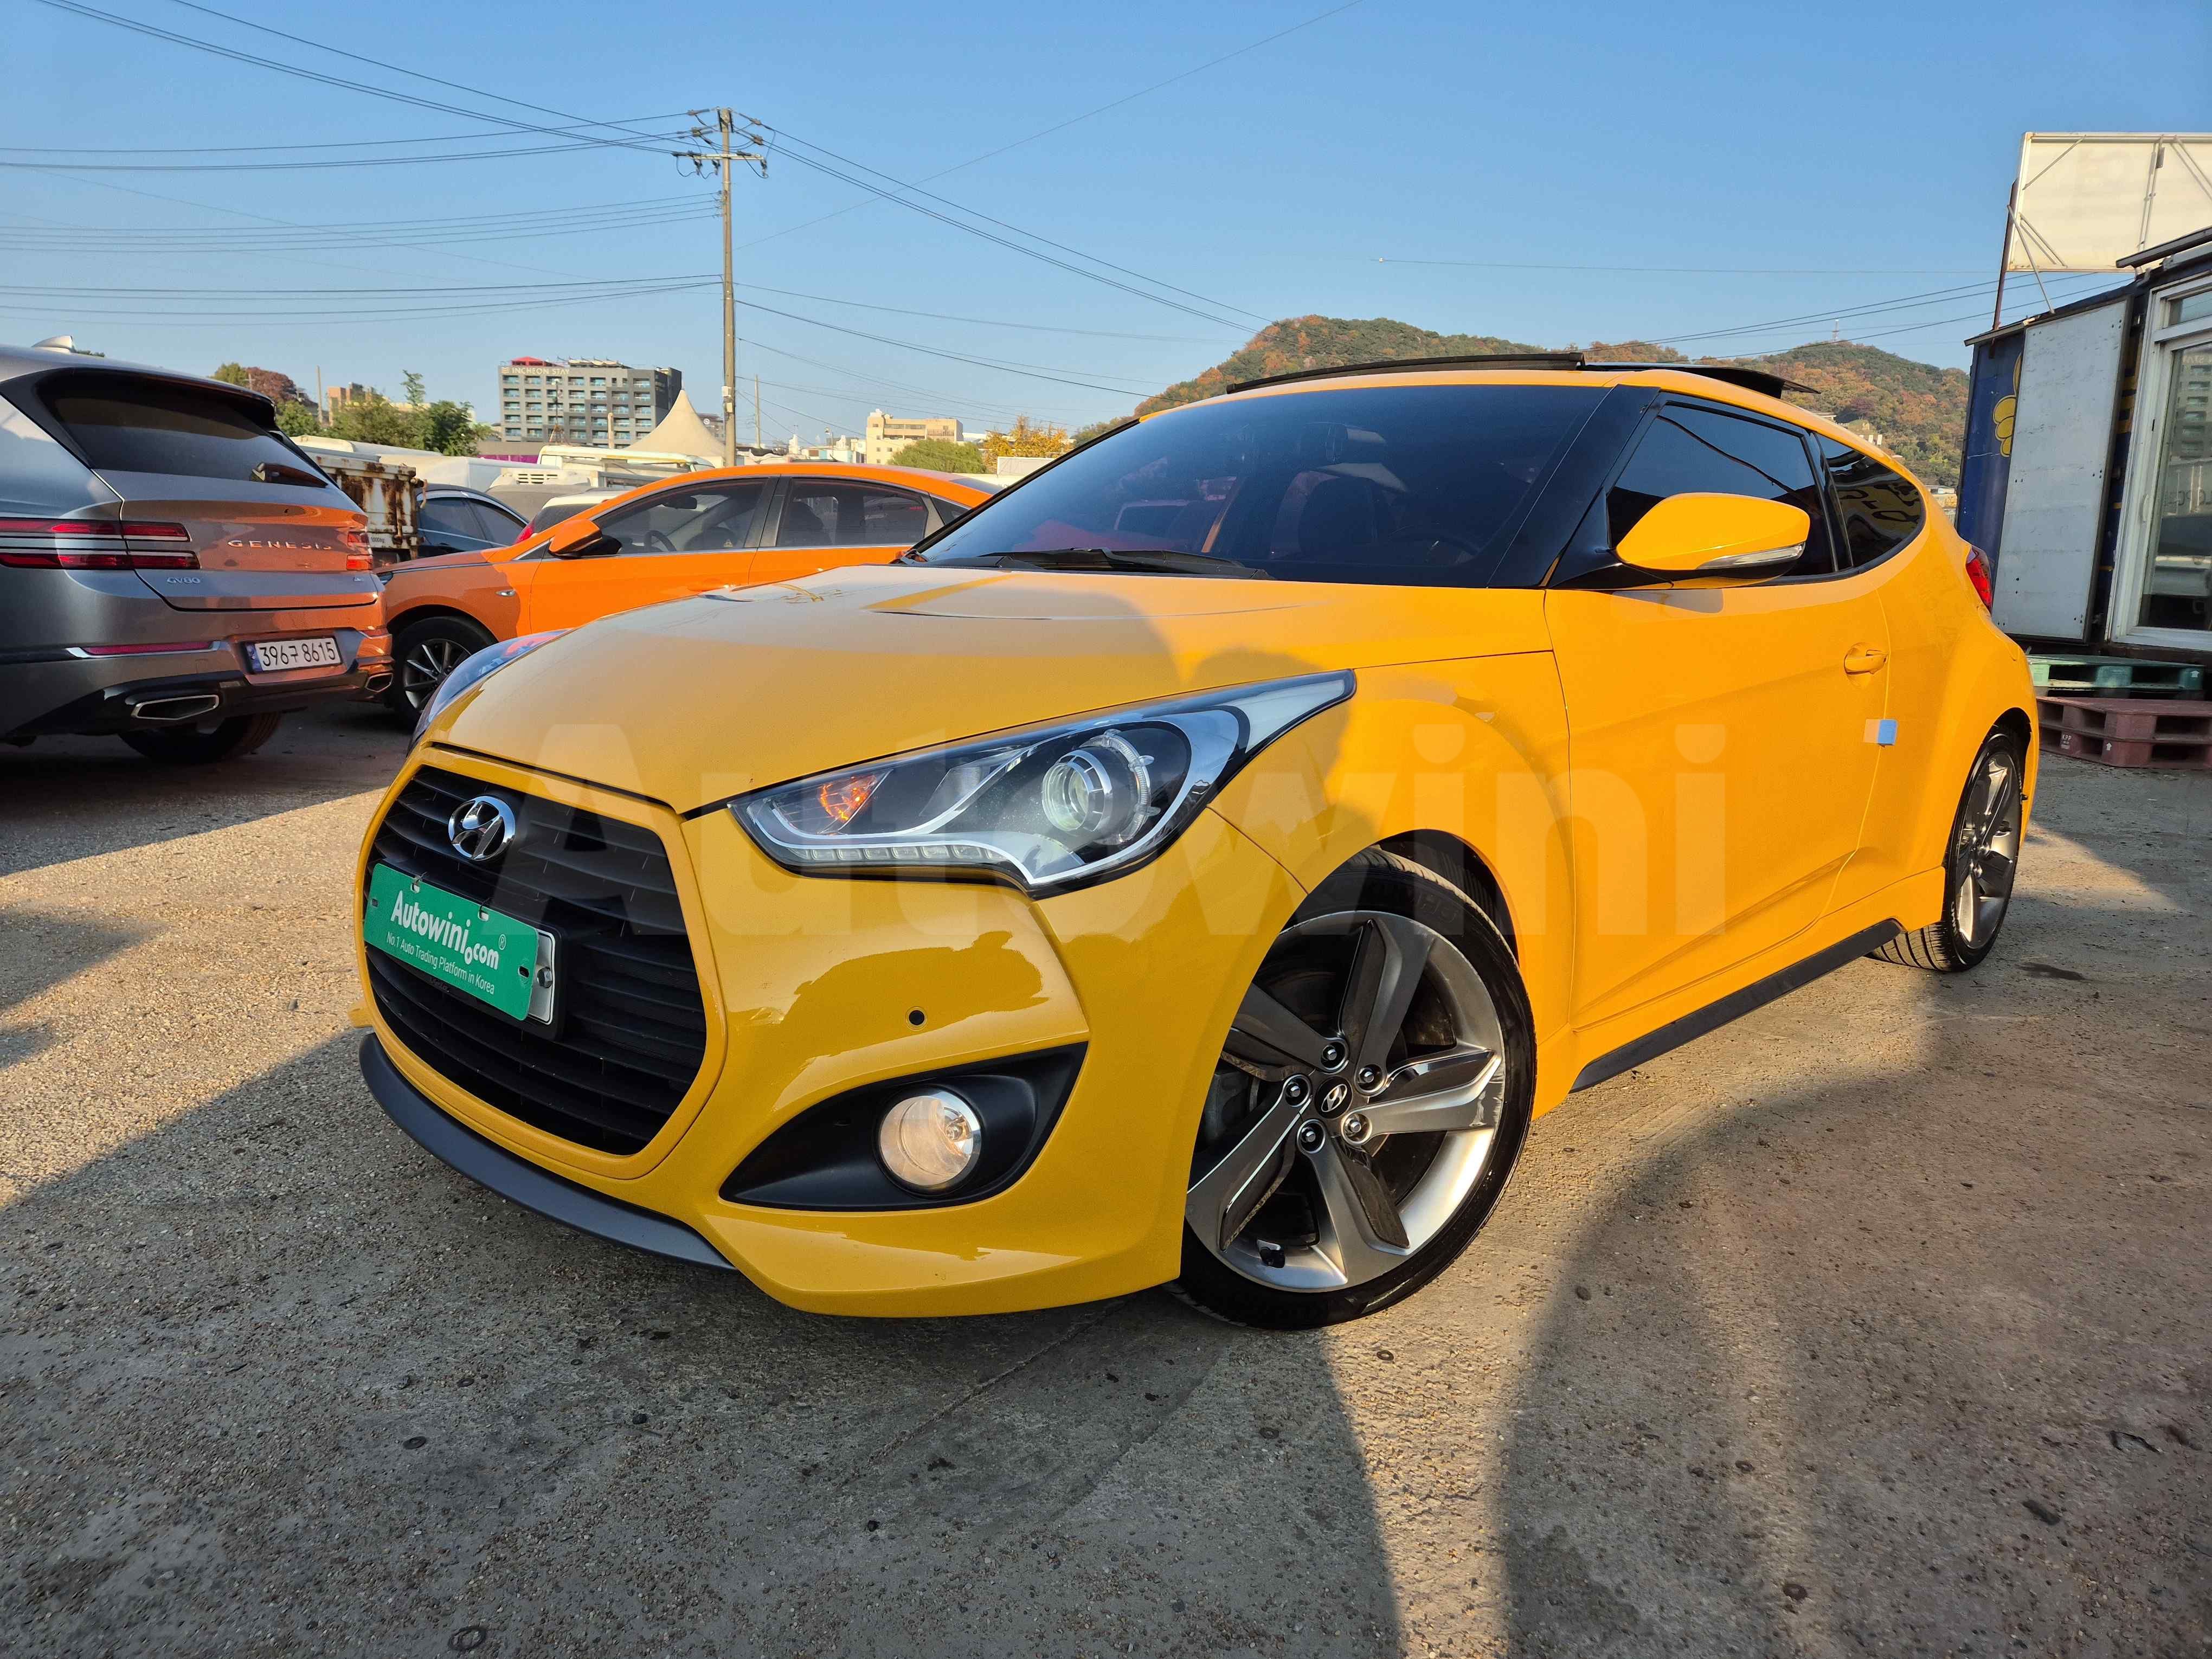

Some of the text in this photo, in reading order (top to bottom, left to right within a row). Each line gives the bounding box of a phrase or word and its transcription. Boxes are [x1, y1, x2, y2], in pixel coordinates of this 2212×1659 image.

[301, 642, 336, 663] 8615
[386, 931, 494, 995] No.1 Auto Trading Platform in Korea
